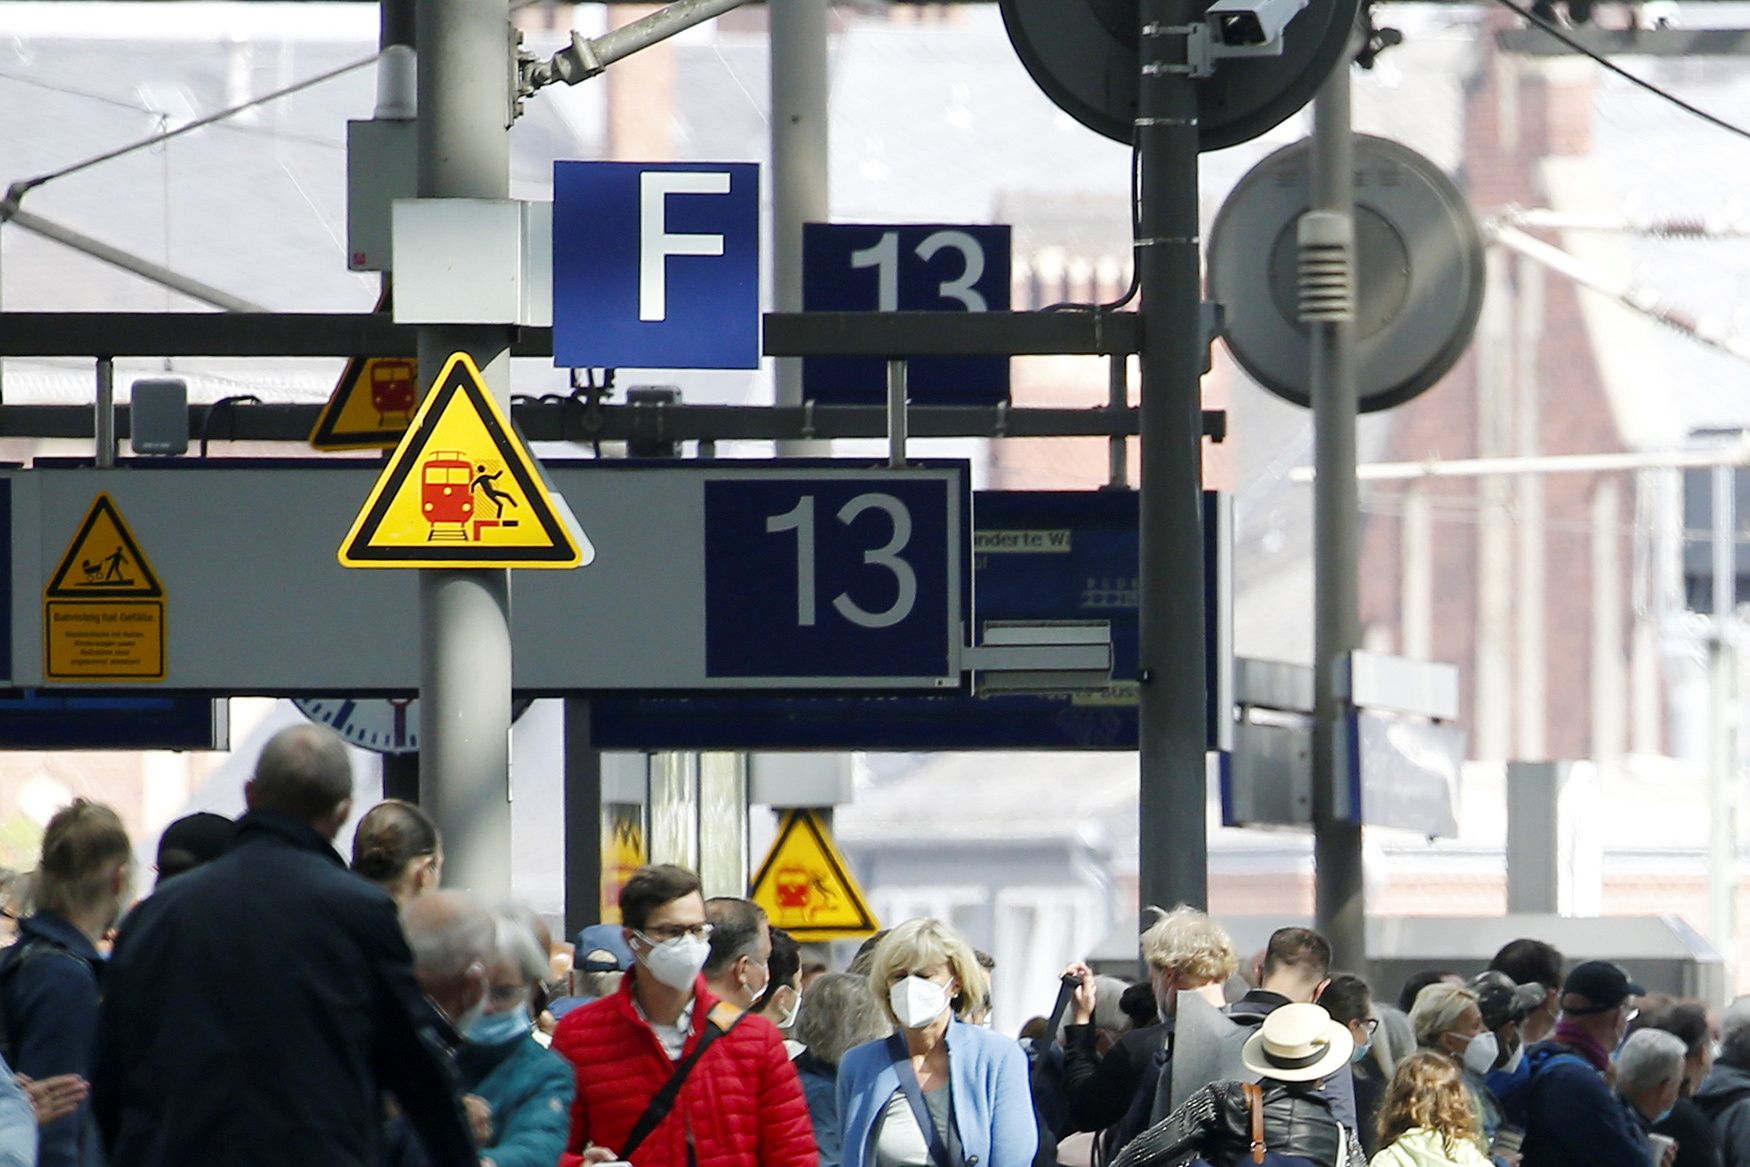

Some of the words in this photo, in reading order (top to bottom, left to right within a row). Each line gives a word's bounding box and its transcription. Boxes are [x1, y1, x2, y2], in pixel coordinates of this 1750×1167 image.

[639, 171, 731, 321] F
[852, 231, 987, 312] 13
[766, 492, 917, 628] 13
